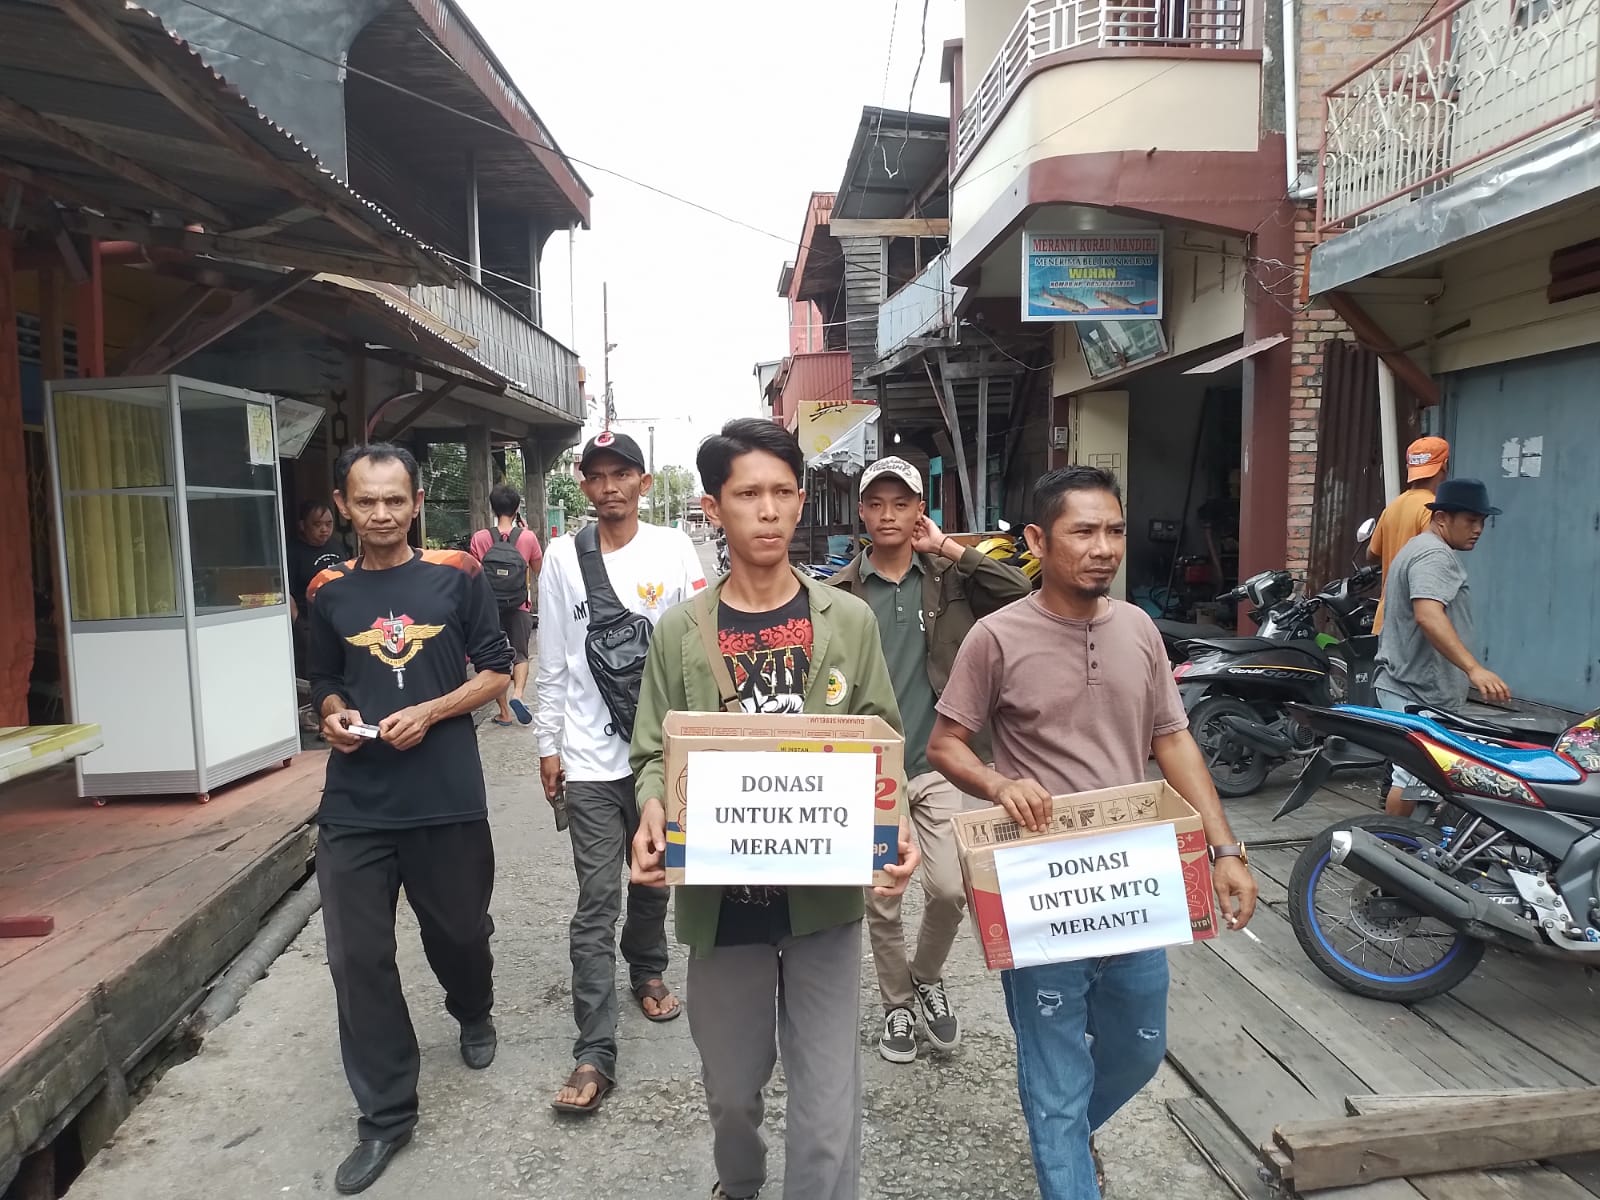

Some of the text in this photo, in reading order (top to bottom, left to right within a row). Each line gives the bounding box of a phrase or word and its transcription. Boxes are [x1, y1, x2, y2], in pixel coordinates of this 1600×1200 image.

[1033, 238, 1155, 252] MERANTI KURAU MANDIRI
[1069, 268, 1117, 279] WIHAN
[741, 775, 824, 793] DONASI
[715, 807, 849, 827] UNTUK MTQ
[730, 838, 832, 855] MERANTI
[1048, 851, 1130, 878] DONASI
[1029, 877, 1161, 911] UNTUK MTQ
[1050, 908, 1149, 937] MERANTI
